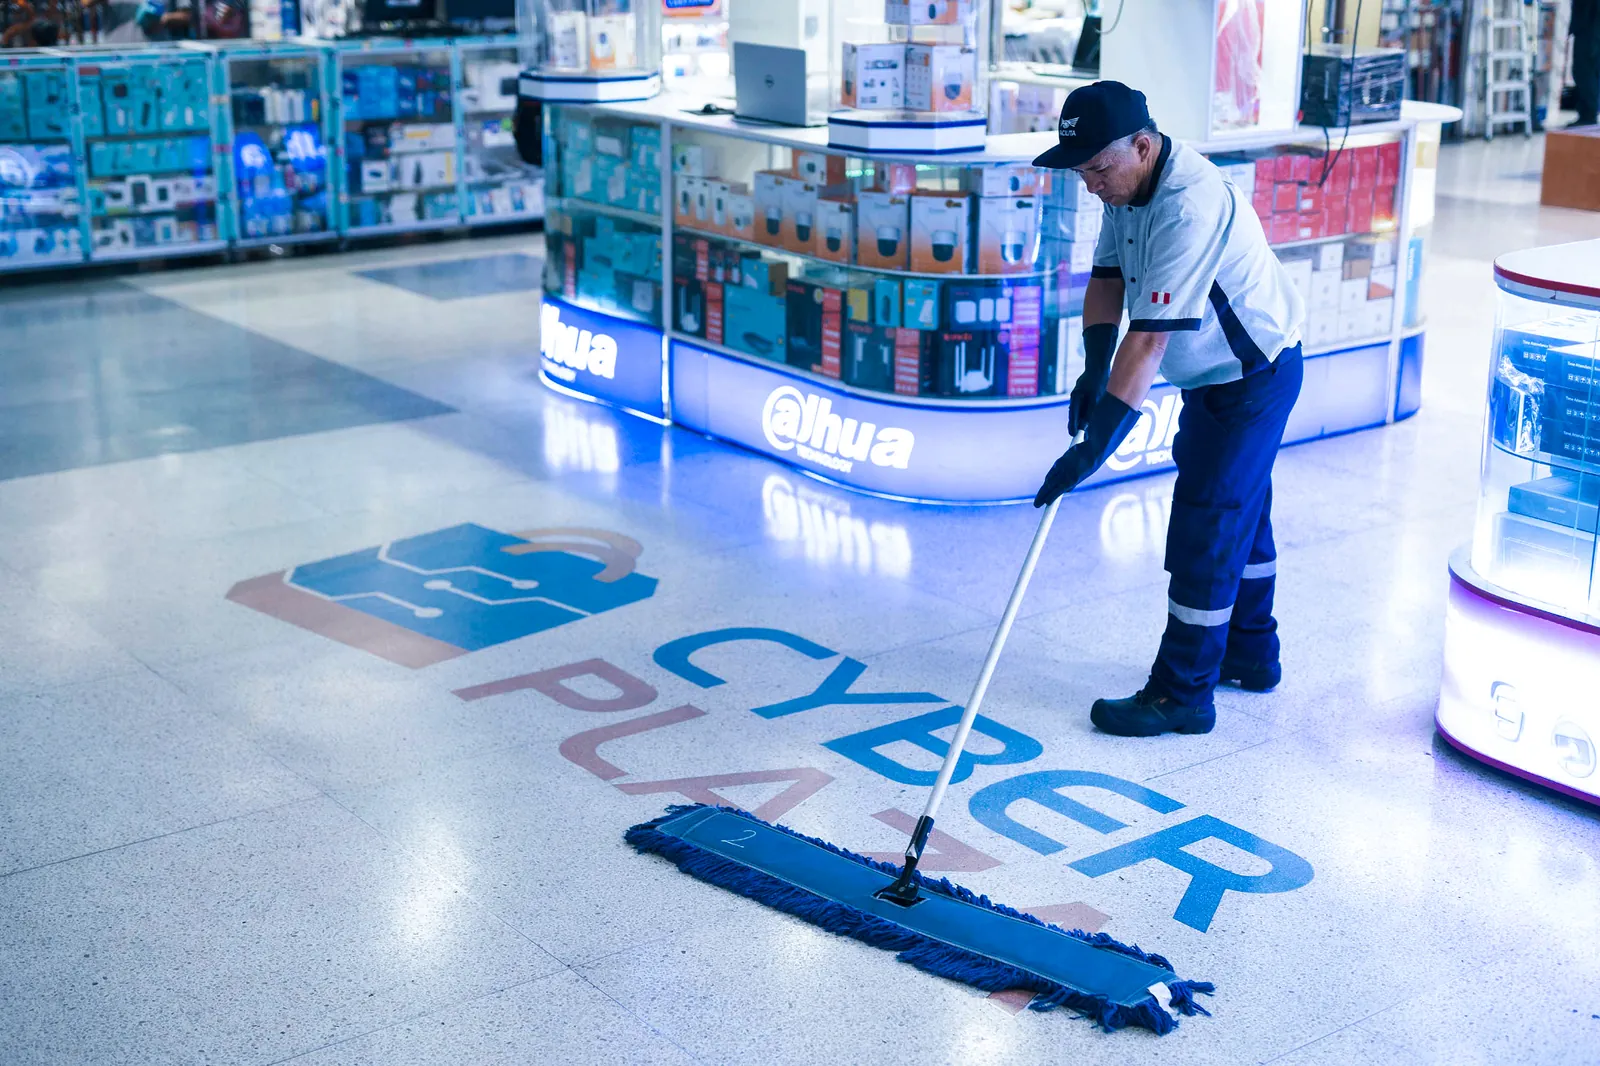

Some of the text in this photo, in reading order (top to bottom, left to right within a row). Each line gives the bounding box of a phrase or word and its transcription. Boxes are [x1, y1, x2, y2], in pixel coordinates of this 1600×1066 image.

[451, 658, 1112, 1017] PLA
[652, 627, 1315, 933] CYBER
[721, 829, 757, 849] 2
